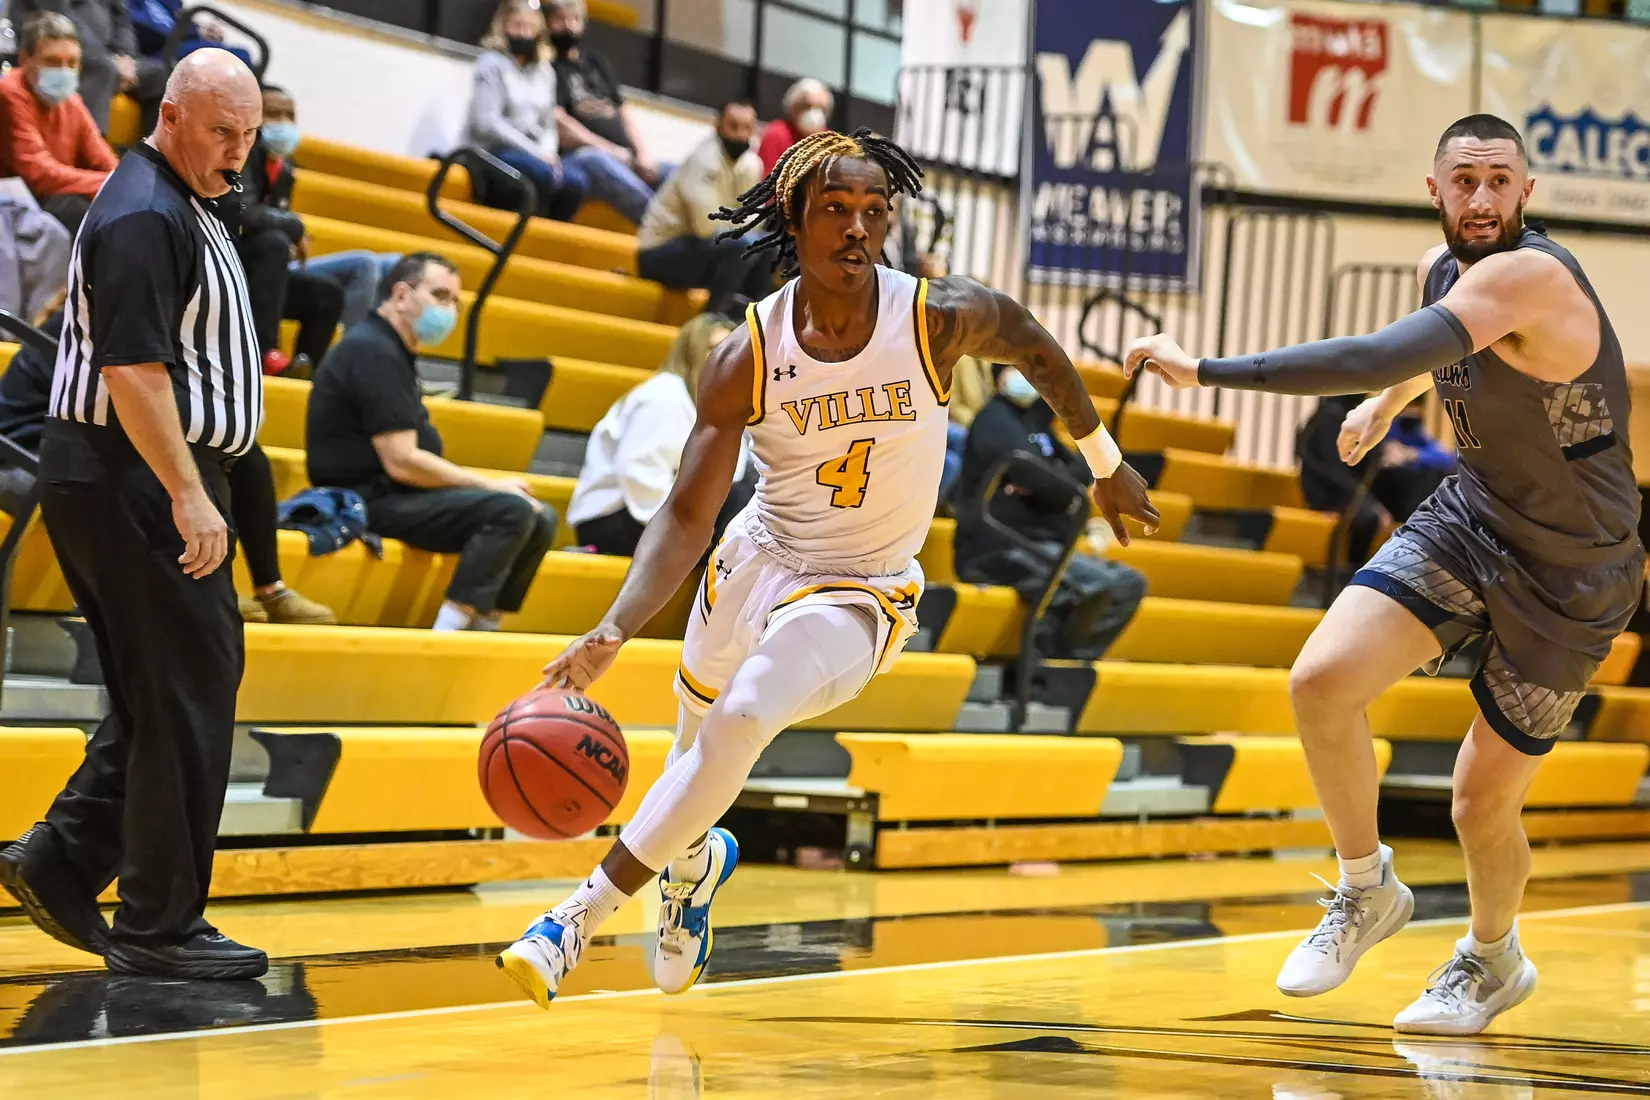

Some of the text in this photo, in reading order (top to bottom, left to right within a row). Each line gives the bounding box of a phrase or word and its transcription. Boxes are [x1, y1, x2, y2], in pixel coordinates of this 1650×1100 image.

[1032, 181, 1182, 236] WEAVER
[781, 379, 916, 435] VILLE
[1443, 398, 1481, 449] 11
[816, 438, 875, 508] 4
